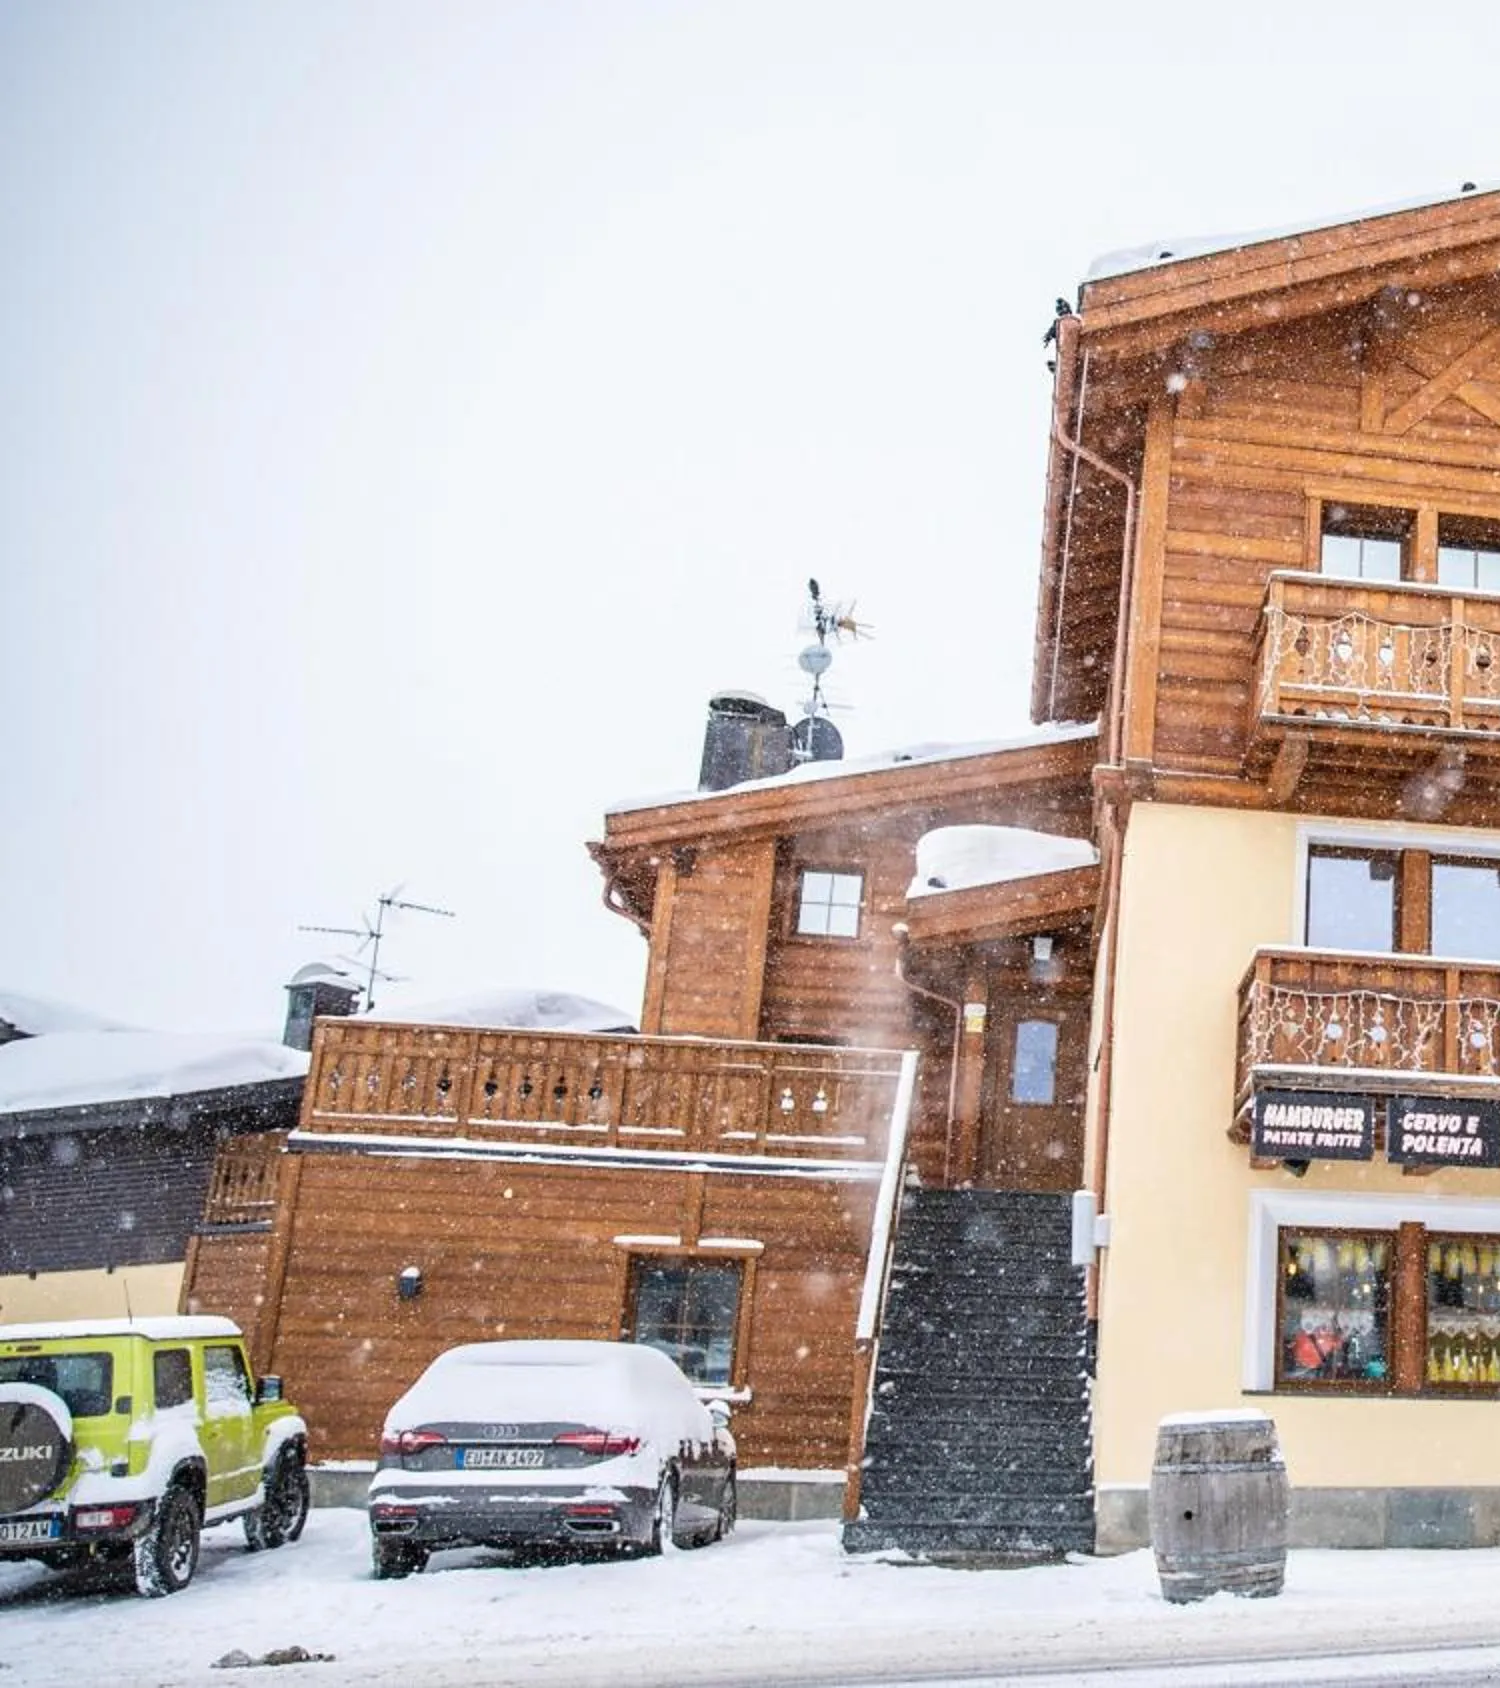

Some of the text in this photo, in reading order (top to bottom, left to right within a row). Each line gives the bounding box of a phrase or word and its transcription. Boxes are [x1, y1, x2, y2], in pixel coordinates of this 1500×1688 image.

[1263, 1104, 1365, 1133] HAMBURGER
[1402, 1113, 1481, 1134] CERVO E
[1263, 1130, 1363, 1148] PATATE FRITTE
[1401, 1134, 1483, 1156] POLENTA
